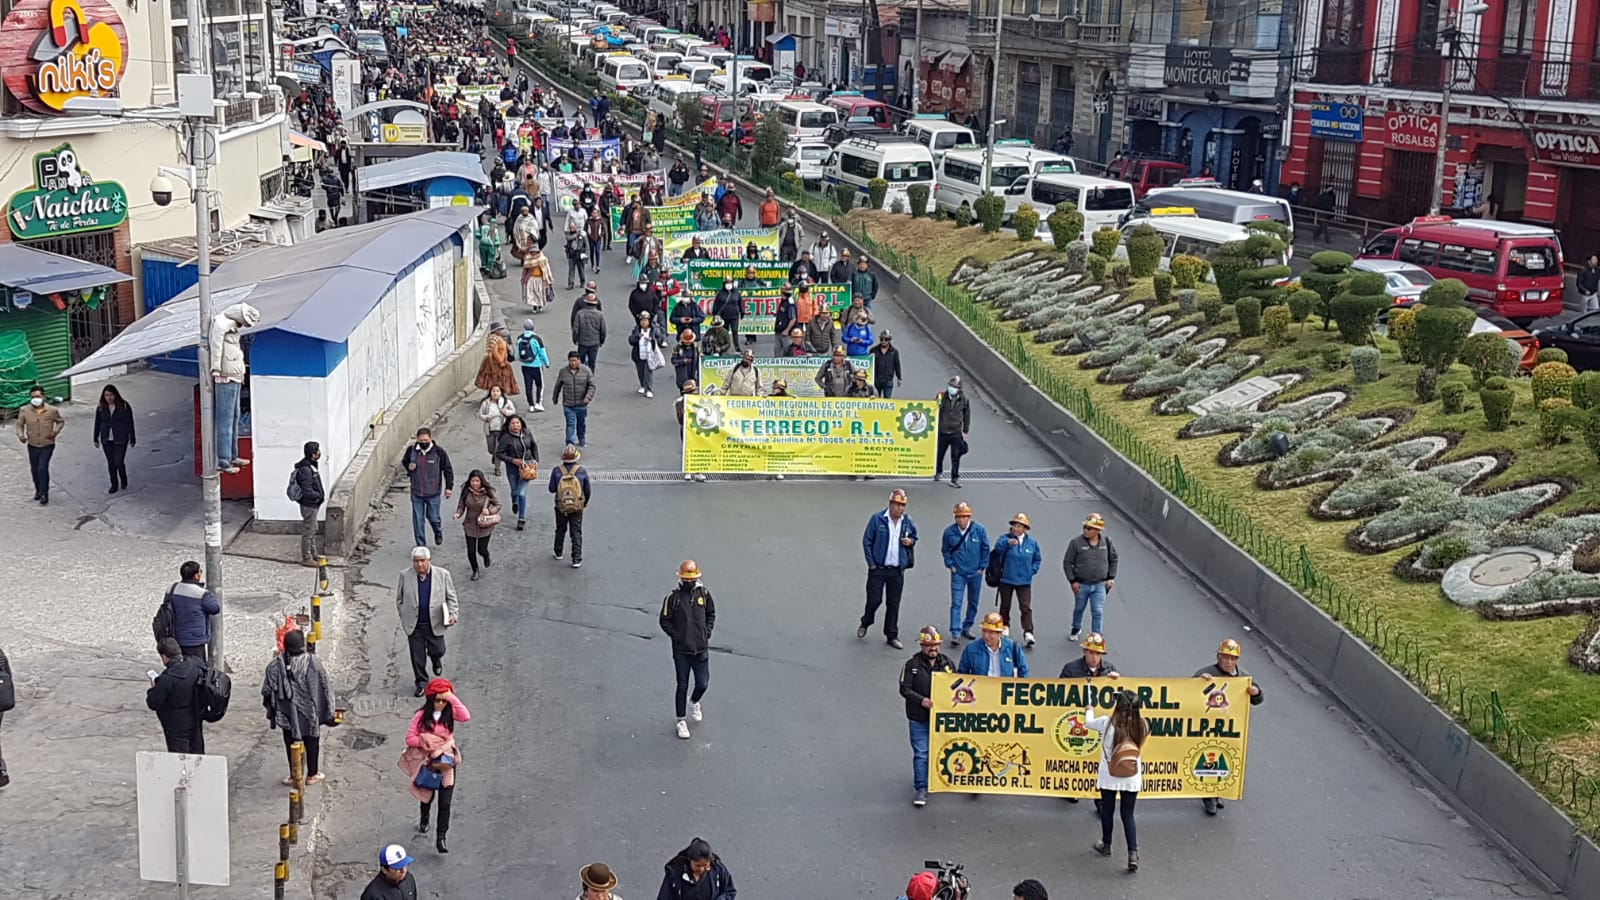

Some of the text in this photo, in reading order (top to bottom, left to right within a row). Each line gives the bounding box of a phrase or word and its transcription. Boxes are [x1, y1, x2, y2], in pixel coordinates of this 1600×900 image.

[1183, 50, 1213, 66] HOTEL
[39, 48, 116, 92] niki's
[293, 64, 319, 75] BAÑOS
[1165, 66, 1198, 84] MONTE
[1199, 69, 1231, 86] CARLO
[1263, 123, 1281, 131] HOTEL
[1388, 114, 1438, 136] OPTICA
[1391, 132, 1436, 147] ROSALES
[1535, 131, 1600, 154] OPTICA
[1232, 150, 1240, 188] HOTEL
[24, 190, 111, 221] Naicha
[72, 216, 98, 228] Perlas
[752, 357, 800, 366] OOPERATIVAS
[726, 399, 895, 411] FEDERACIÓN REGIONAL DE COOPERATIVAS
[759, 409, 796, 417] MINERAS
[797, 409, 843, 418] AURIFERAS
[850, 420, 891, 437] R.L.
[1001, 682, 1180, 710] FECMABO R.L.
[935, 711, 1010, 734] FERRECO
[1014, 713, 1044, 734] R.L.
[1045, 758, 1178, 775] MARCHA POR DICACION
[953, 775, 1033, 788] FERRECO R.L.
[1040, 776, 1051, 790] DE
[1053, 777, 1069, 791] LAS
[1140, 778, 1182, 792] URIFERAS
